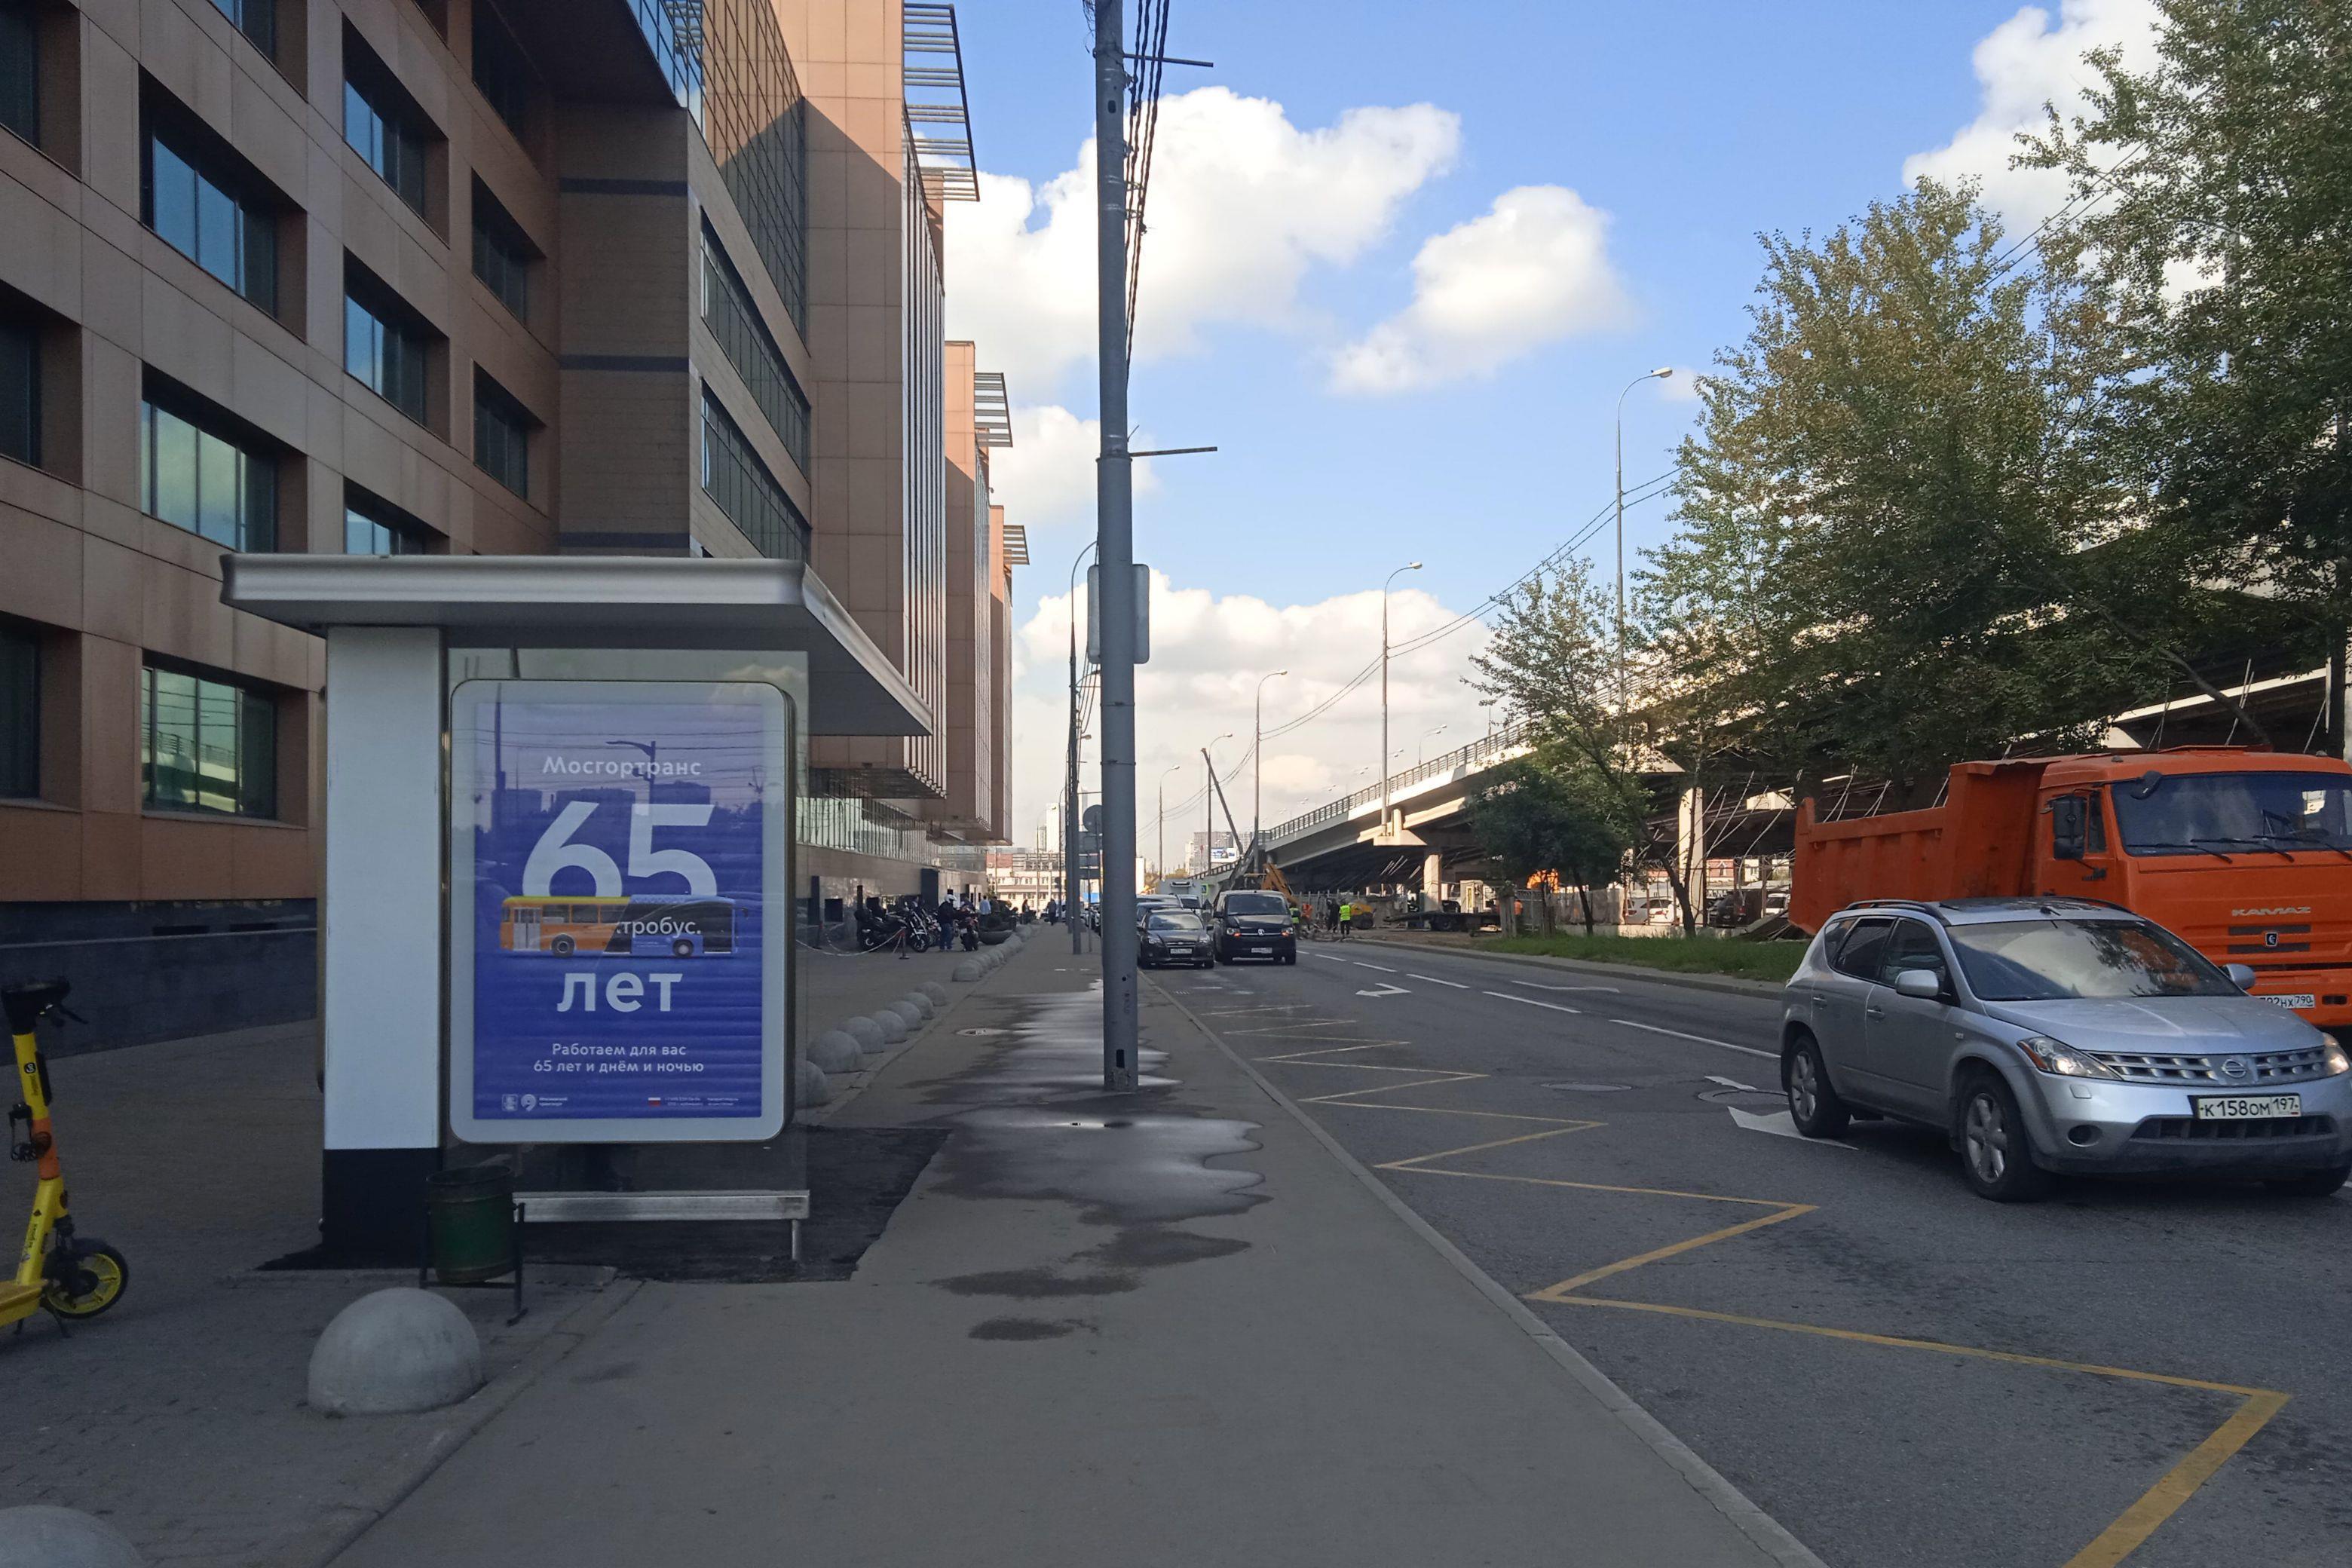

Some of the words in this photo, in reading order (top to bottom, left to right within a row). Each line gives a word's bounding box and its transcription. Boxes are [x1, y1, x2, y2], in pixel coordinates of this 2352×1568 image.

[542, 756, 702, 779] Мосгортранс
[522, 801, 718, 897] 65
[2231, 907, 2311, 916] KAMAZ
[556, 972, 684, 1012] лет
[552, 1043, 626, 1055] Работаем
[629, 1046, 657, 1057] для
[661, 1046, 687, 1055] вас
[533, 1060, 553, 1072] 65
[556, 1062, 582, 1072] лет
[586, 1063, 595, 1072] и
[599, 1060, 639, 1073] днём
[643, 1063, 651, 1072] и
[657, 1062, 704, 1072] ночью
